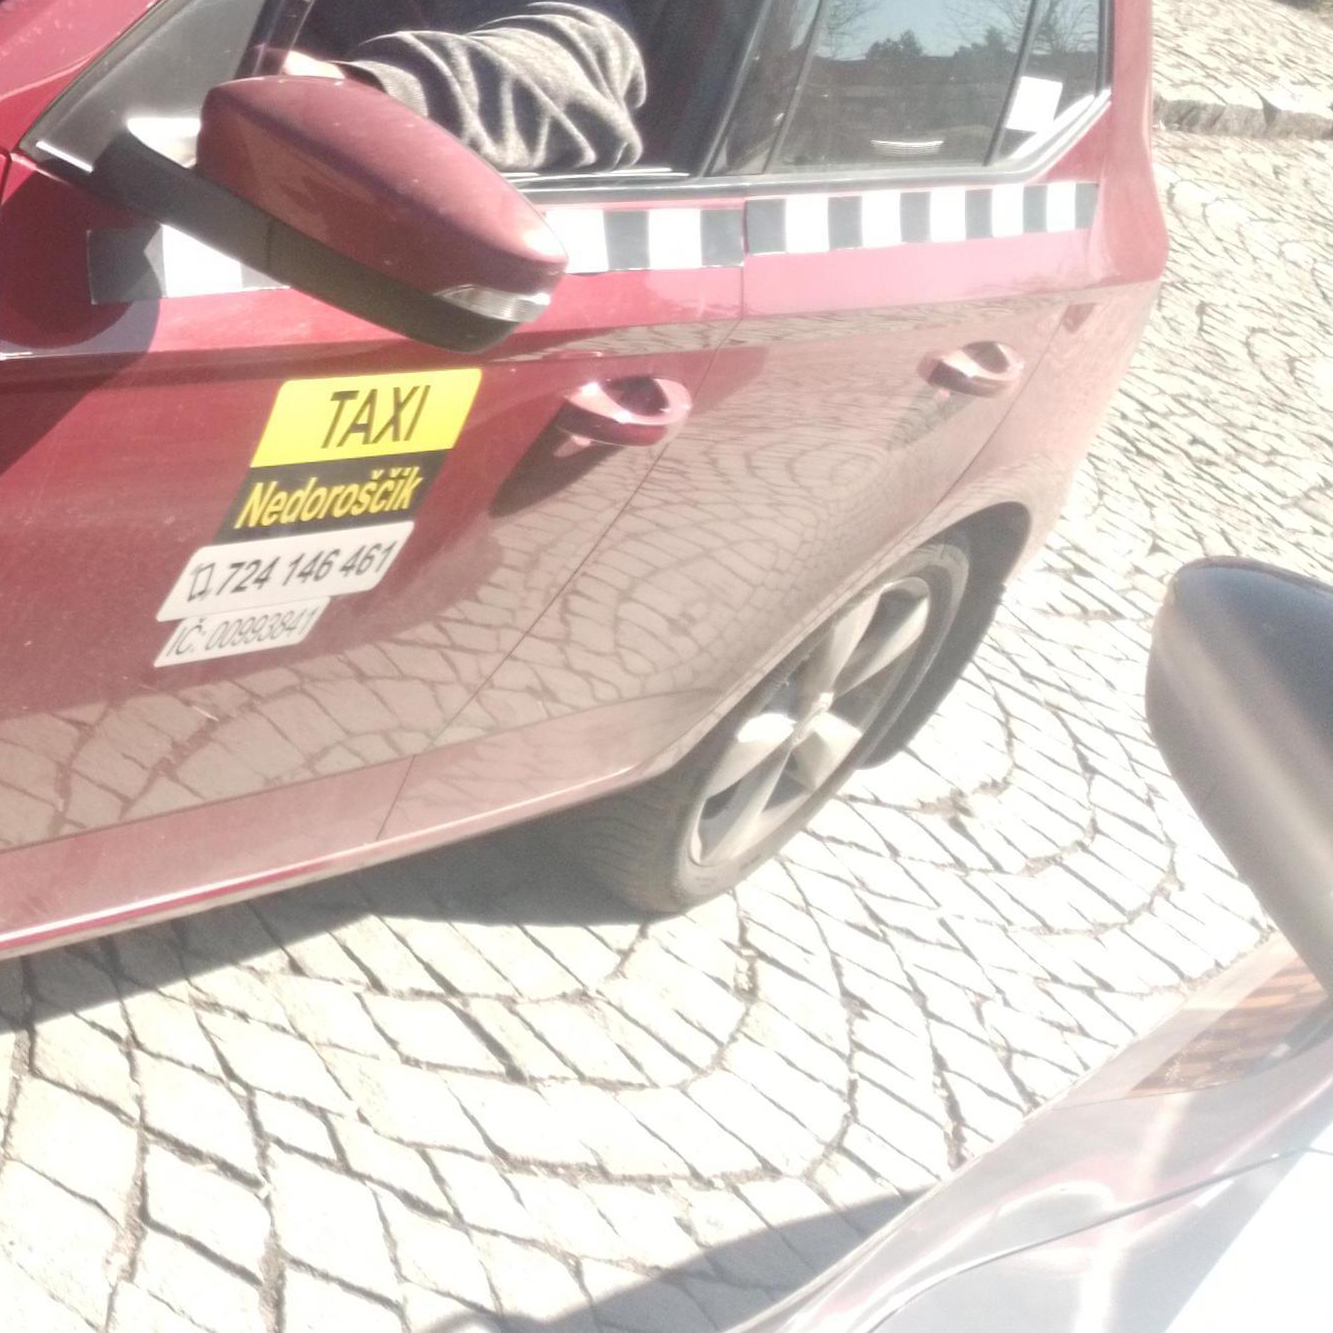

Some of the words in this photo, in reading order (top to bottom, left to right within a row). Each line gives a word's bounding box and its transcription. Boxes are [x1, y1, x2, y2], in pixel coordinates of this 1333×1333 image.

[320, 384, 431, 449] TAXI
[234, 466, 423, 530] Nedoroščik
[216, 557, 281, 596] 724
[282, 548, 341, 587] 146
[339, 540, 398, 578] 461
